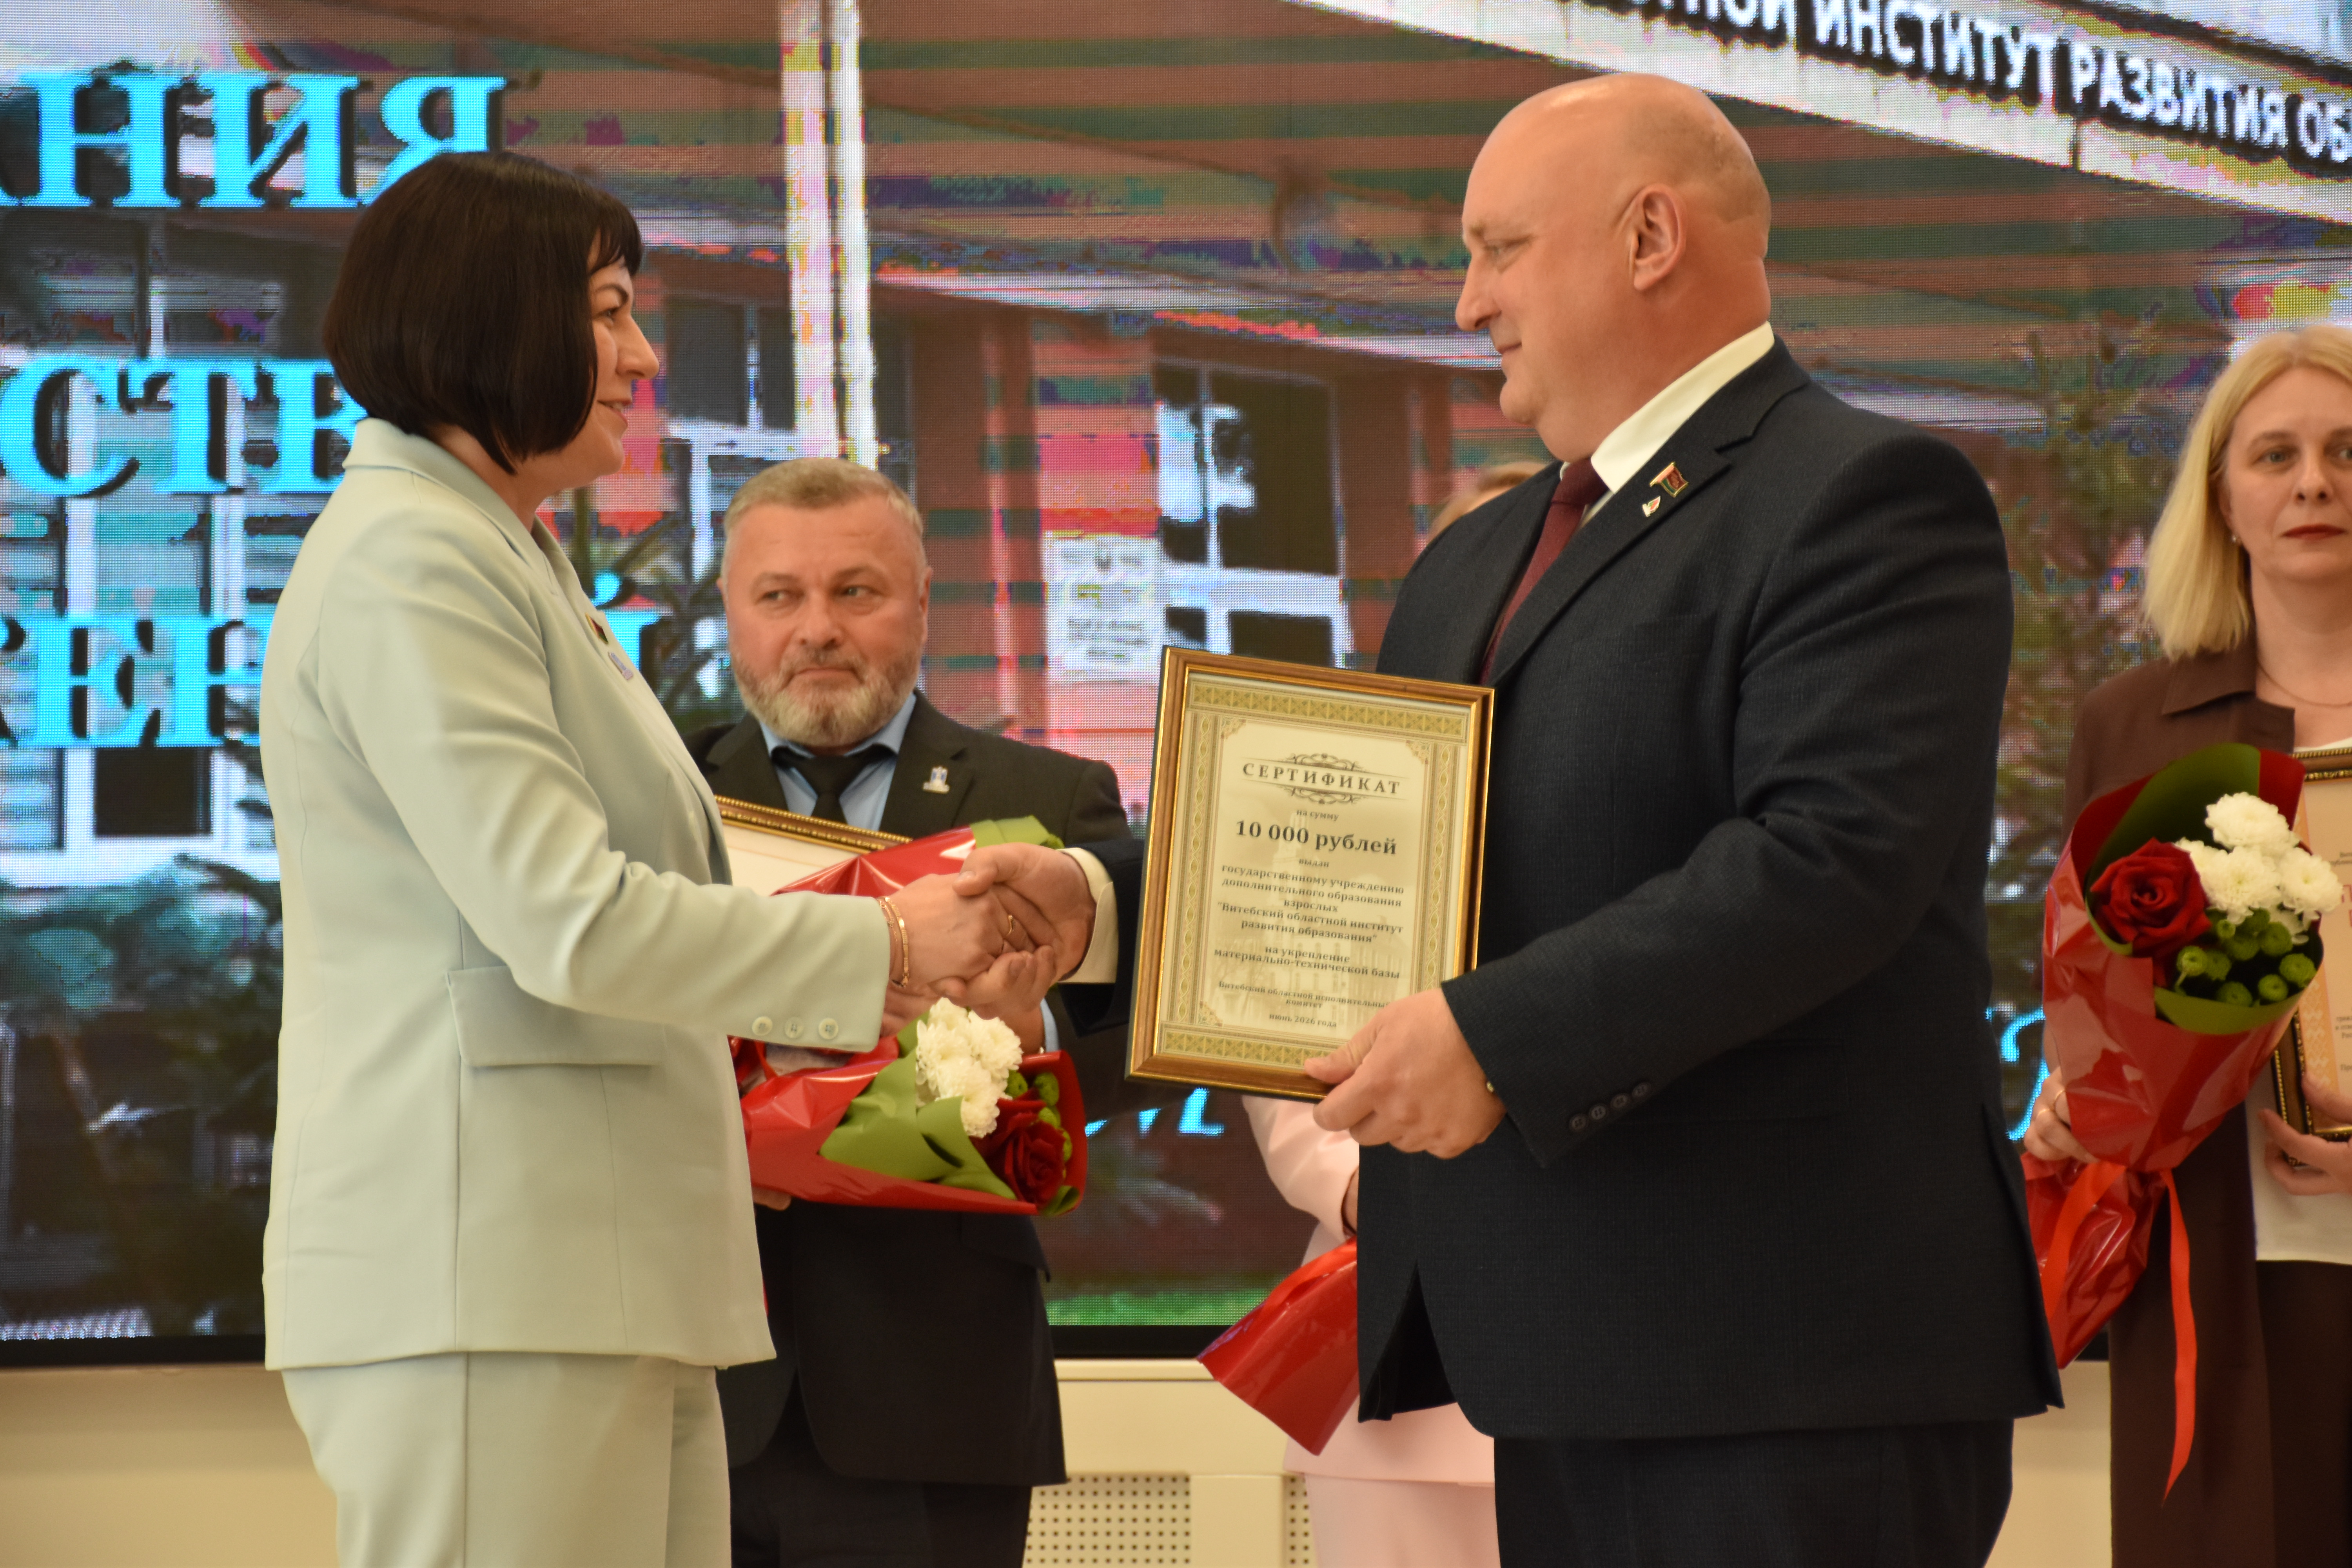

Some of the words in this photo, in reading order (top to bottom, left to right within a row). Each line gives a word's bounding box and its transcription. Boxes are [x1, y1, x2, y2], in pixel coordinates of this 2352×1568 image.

[1812, 0, 2057, 103] ИНСТИТУТ
[2069, 41, 2288, 148] РАЗВИТИЯ
[0, 72, 506, 208] НИЯ
[1243, 763, 1400, 794] СЕРТИФИКАТ
[1310, 811, 1339, 821] сумму
[1236, 820, 1261, 837] 10
[1269, 824, 1308, 844] 000
[1315, 833, 1397, 855] рублей
[1299, 858, 1329, 867] выдан
[1221, 864, 1327, 886] государственному
[1330, 879, 1404, 895] учреждению
[1222, 877, 1325, 898] дополнительного
[1327, 892, 1402, 907] образования
[1218, 902, 1284, 919] "Витебский
[1287, 911, 1347, 926] областной
[1350, 921, 1404, 934] институт
[1283, 899, 1339, 913] взрослых
[1241, 919, 1294, 933] развития
[1214, 949, 1368, 975] материально-технической
[1371, 967, 1400, 978] базы
[1281, 949, 1350, 963] укрепление
[1219, 981, 1266, 994] Витебский
[1268, 989, 1313, 1000] областной
[1286, 999, 1323, 1009] комитет
[1269, 1013, 1292, 1022] июнь
[1294, 1016, 1315, 1025] 2026
